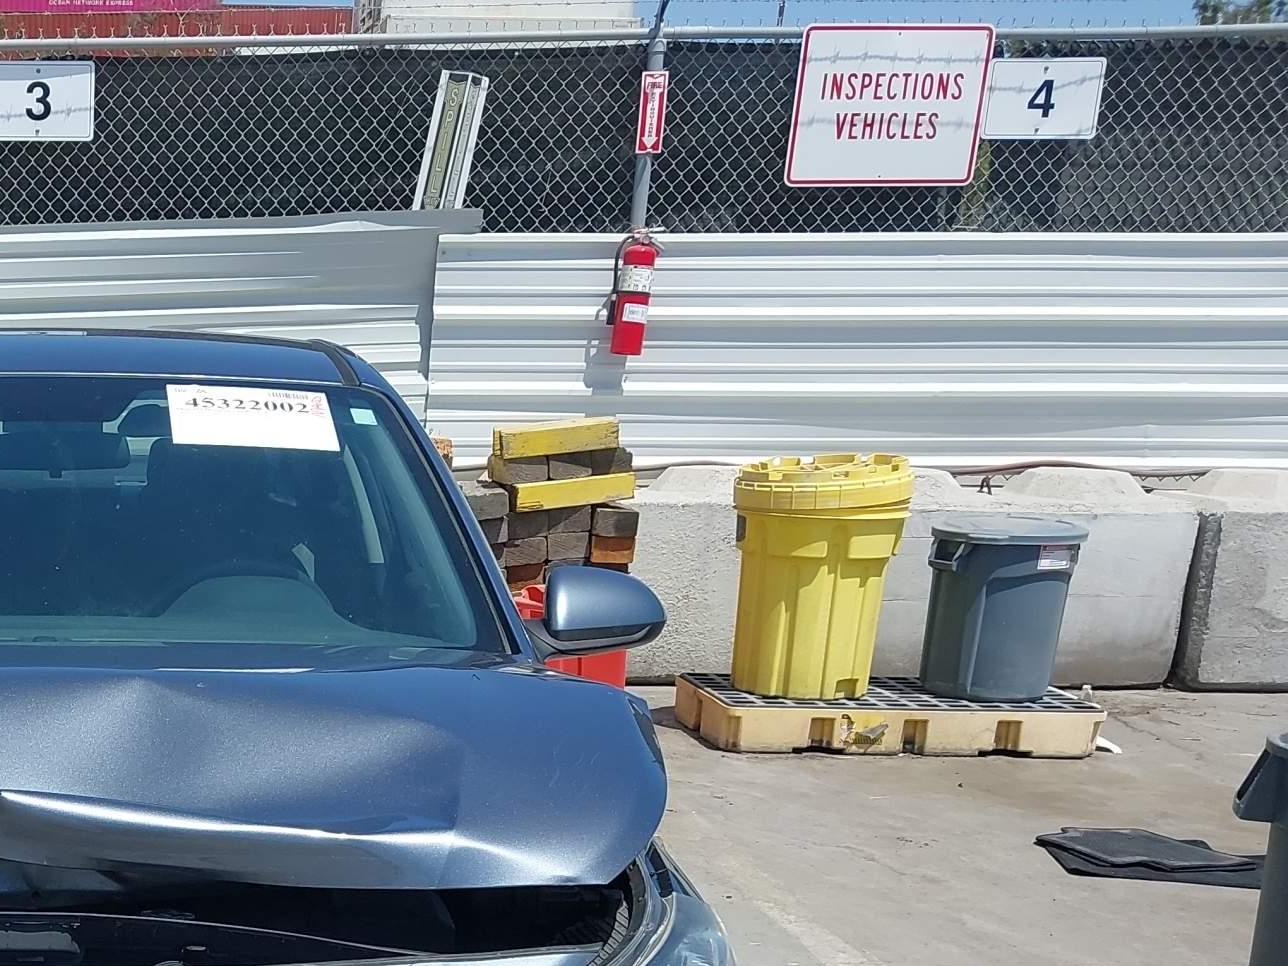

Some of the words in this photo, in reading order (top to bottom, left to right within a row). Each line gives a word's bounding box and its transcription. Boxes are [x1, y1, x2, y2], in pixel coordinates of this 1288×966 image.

[25, 81, 52, 121] 3
[820, 73, 965, 100] INSPECTIONS
[1027, 79, 1055, 118] 4
[431, 88, 459, 193] SPILL
[835, 112, 939, 140] VEHICLES
[185, 397, 309, 413] 45322002
